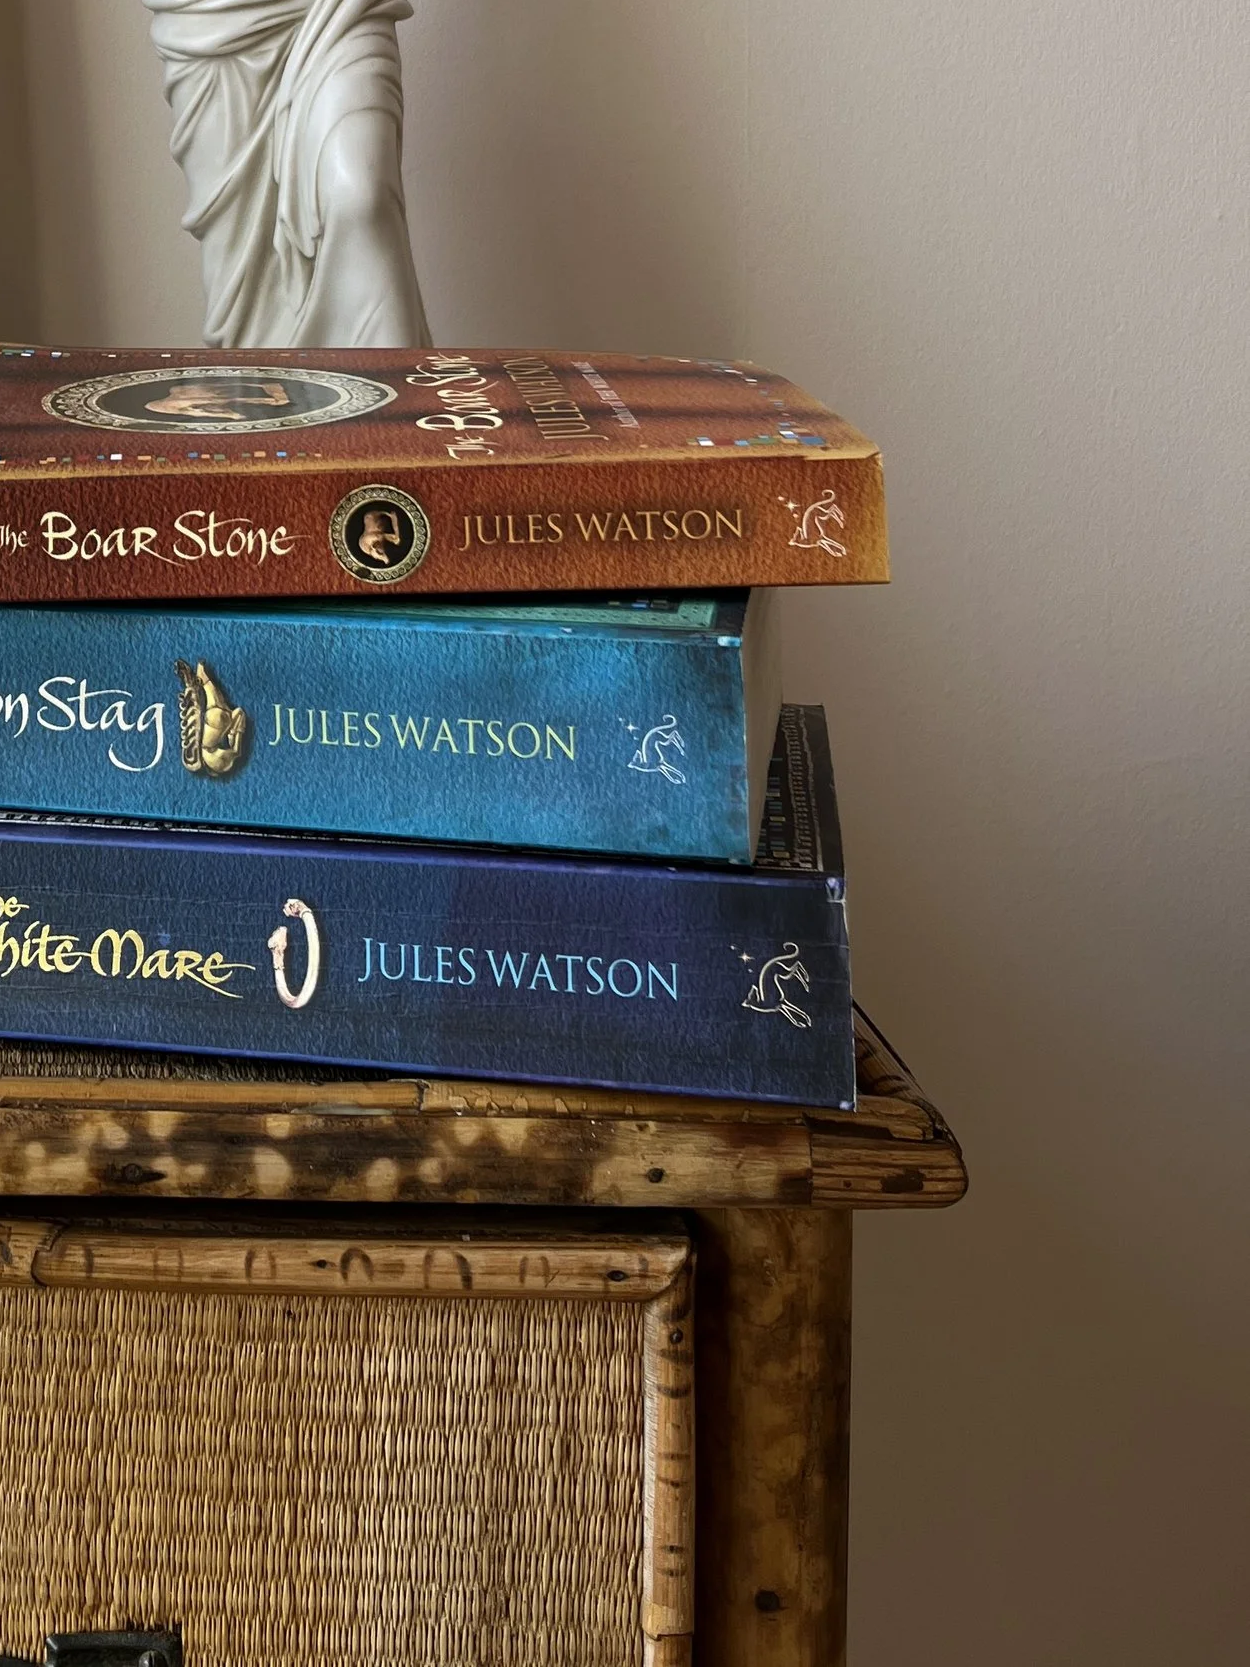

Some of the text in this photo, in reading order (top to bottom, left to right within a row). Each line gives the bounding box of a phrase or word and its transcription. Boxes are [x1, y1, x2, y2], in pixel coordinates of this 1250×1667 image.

[405, 352, 490, 386] Stone
[497, 356, 609, 441] JULES WATSON
[611, 407, 641, 429] Author
[444, 433, 499, 460] The
[172, 509, 312, 567] Stone
[459, 508, 743, 552] JULES WATSON
[36, 675, 166, 773] Stag
[268, 702, 577, 762] JULES WATSON
[357, 936, 680, 1002] JULES WATSON
